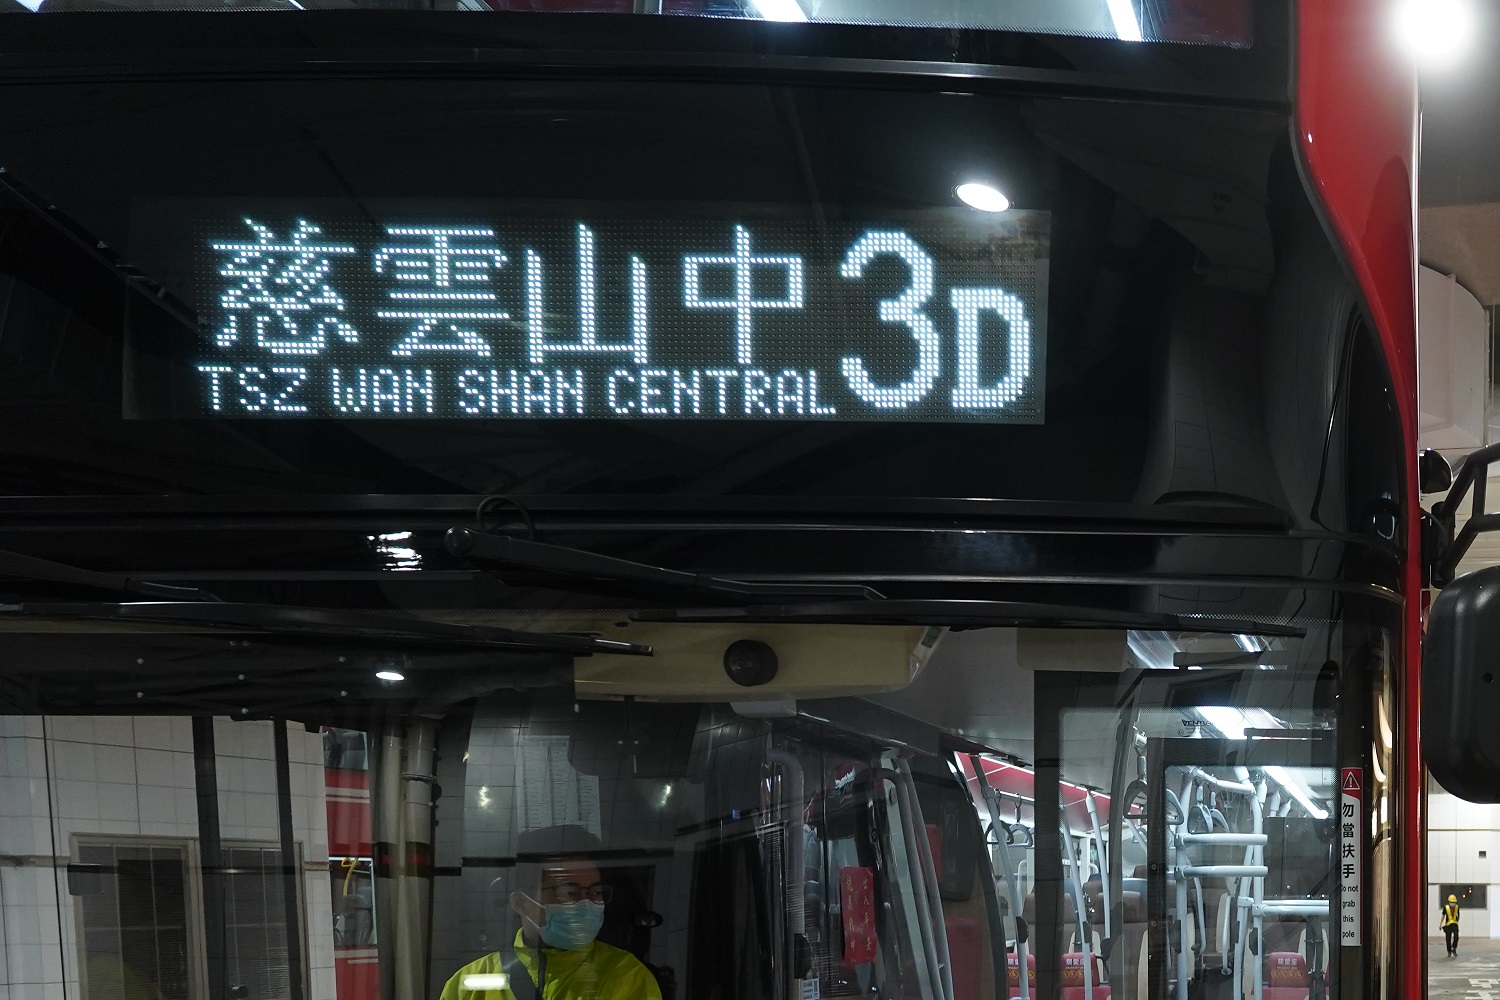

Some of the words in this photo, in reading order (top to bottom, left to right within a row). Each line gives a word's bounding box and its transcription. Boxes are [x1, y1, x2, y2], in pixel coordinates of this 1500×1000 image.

[211, 218, 804, 365] 慈雲山中
[841, 231, 1030, 409] 3D
[197, 365, 308, 412] TSZ
[331, 367, 434, 413] WAN
[457, 369, 584, 414] SHAN
[607, 369, 837, 415] CENTRAL
[1342, 802, 1356, 879] 勿當扶手
[1343, 915, 1355, 923] this
[1348, 884, 1359, 892] not
